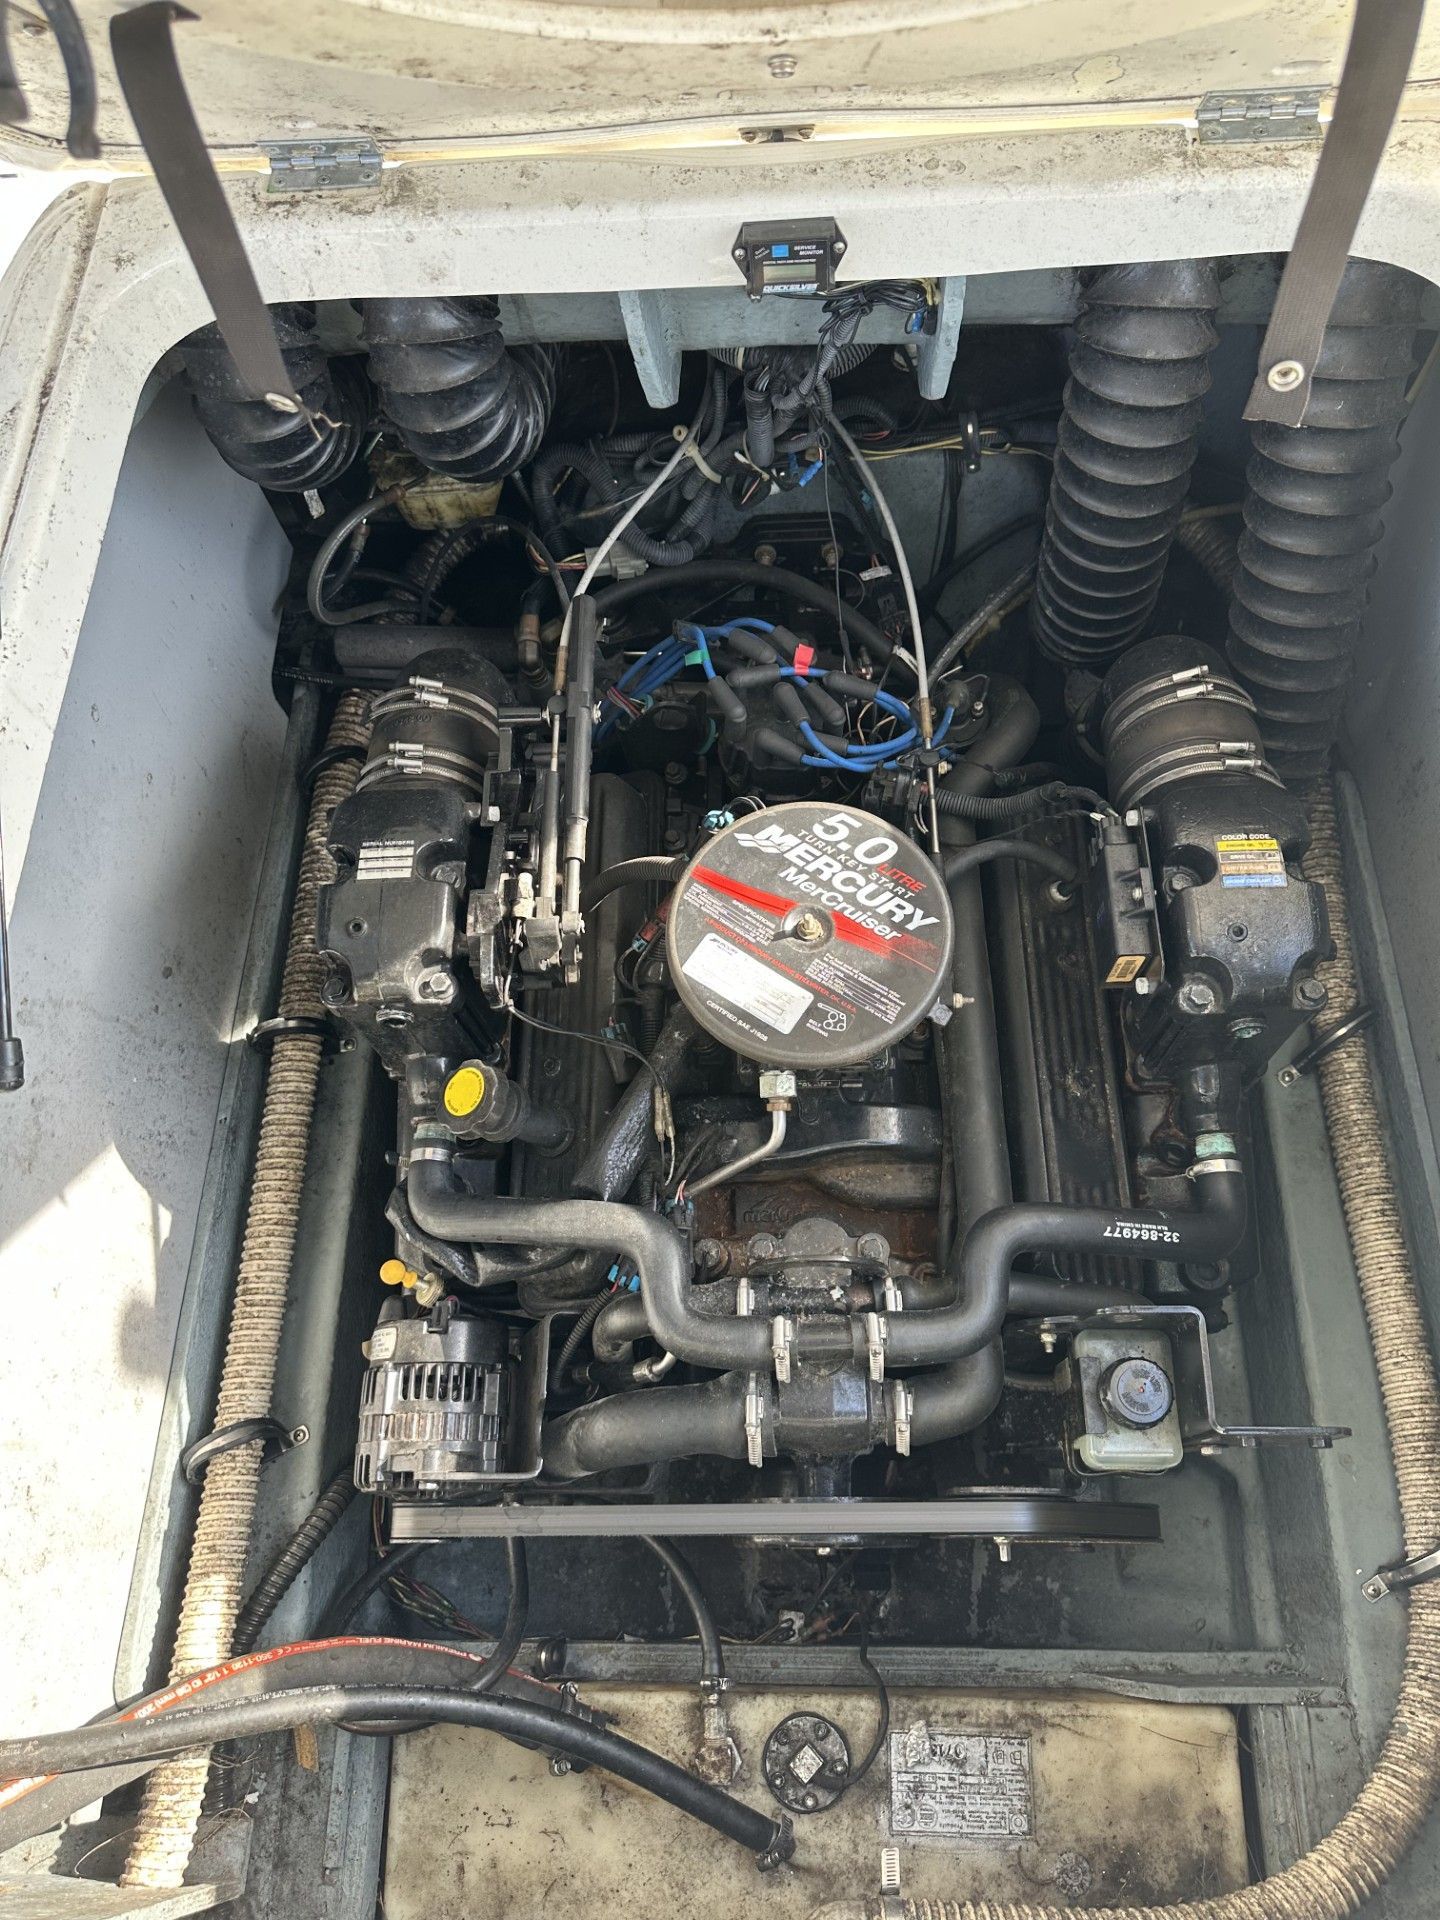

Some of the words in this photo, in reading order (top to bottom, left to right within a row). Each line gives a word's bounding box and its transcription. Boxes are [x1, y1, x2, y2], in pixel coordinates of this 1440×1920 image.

[812, 812, 898, 866] 5.0
[754, 824, 940, 930] MERCURY
[797, 829, 836, 856] TURN
[838, 853, 868, 872] KEY
[868, 872, 916, 898] START
[875, 863, 927, 894] LITRE
[778, 866, 903, 941] MerCruiser
[705, 999, 738, 1022] CERTIFIED
[736, 1019, 750, 1030] SAE
[1103, 1226, 1180, 1243] 32-864977
[355, 1635, 381, 1645] FUEL
[383, 1636, 421, 1647] MARINE
[422, 1642, 467, 1655] PREMIUM
